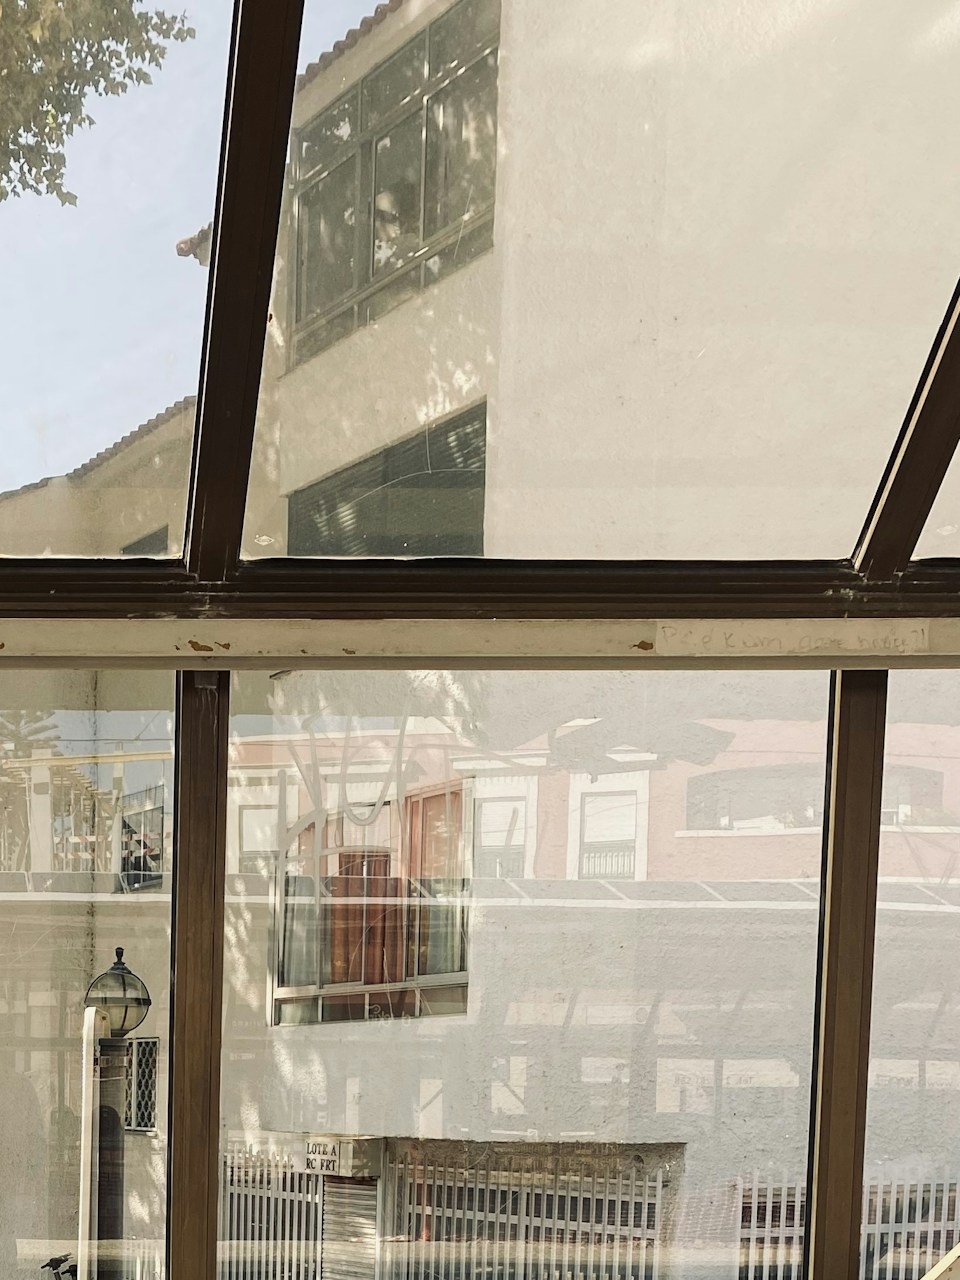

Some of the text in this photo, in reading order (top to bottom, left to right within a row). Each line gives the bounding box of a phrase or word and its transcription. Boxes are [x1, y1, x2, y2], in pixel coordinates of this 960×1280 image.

[306, 1142, 337, 1156] LOTE A
[305, 1157, 337, 1172] RC FRT
